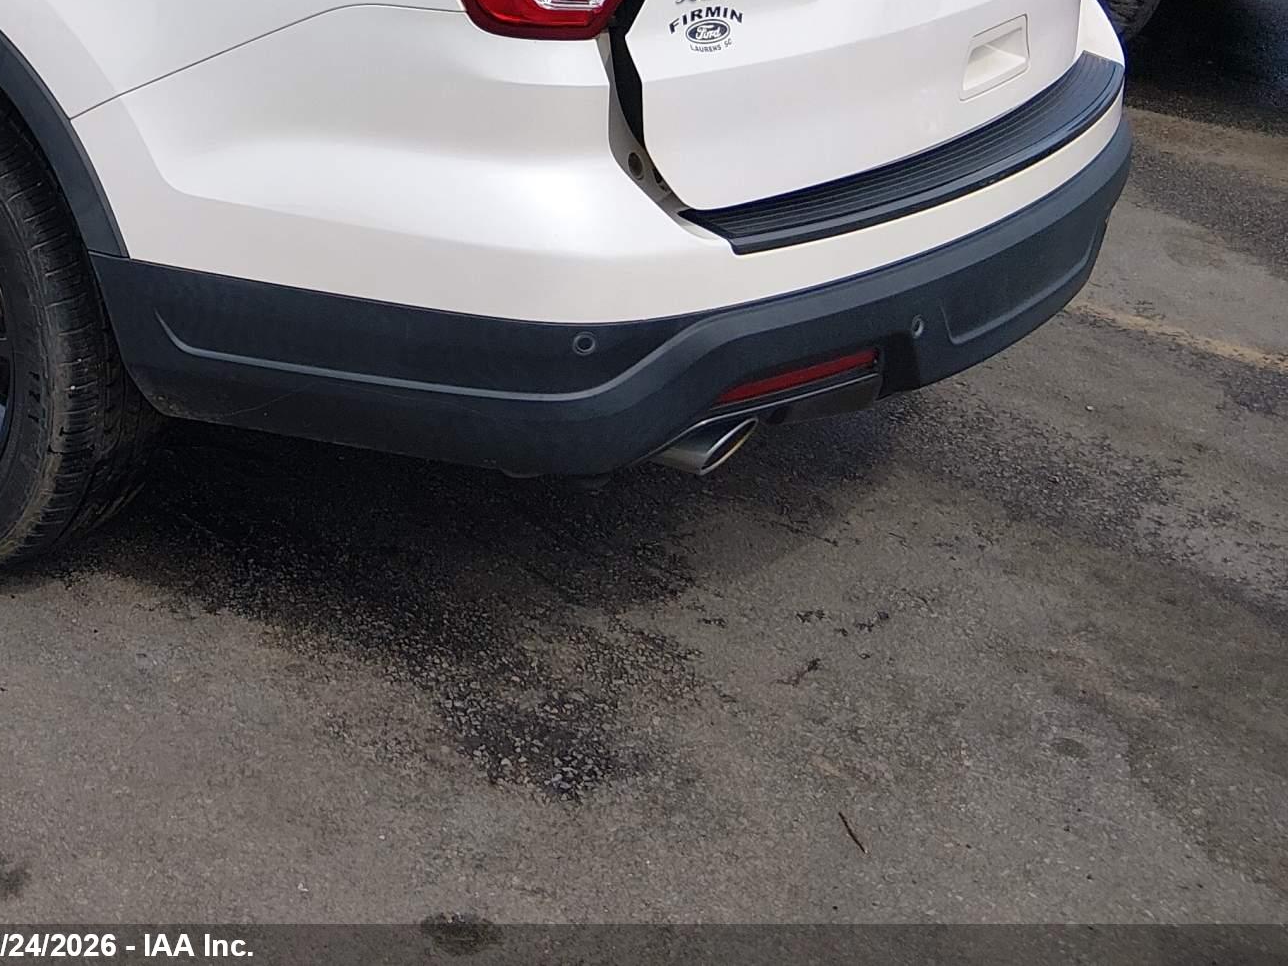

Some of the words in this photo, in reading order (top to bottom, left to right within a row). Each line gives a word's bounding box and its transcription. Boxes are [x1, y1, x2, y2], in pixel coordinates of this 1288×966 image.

[669, 6, 743, 35] FIRMIN
[695, 25, 721, 40] Ford
[690, 44, 722, 53] LAURENS
